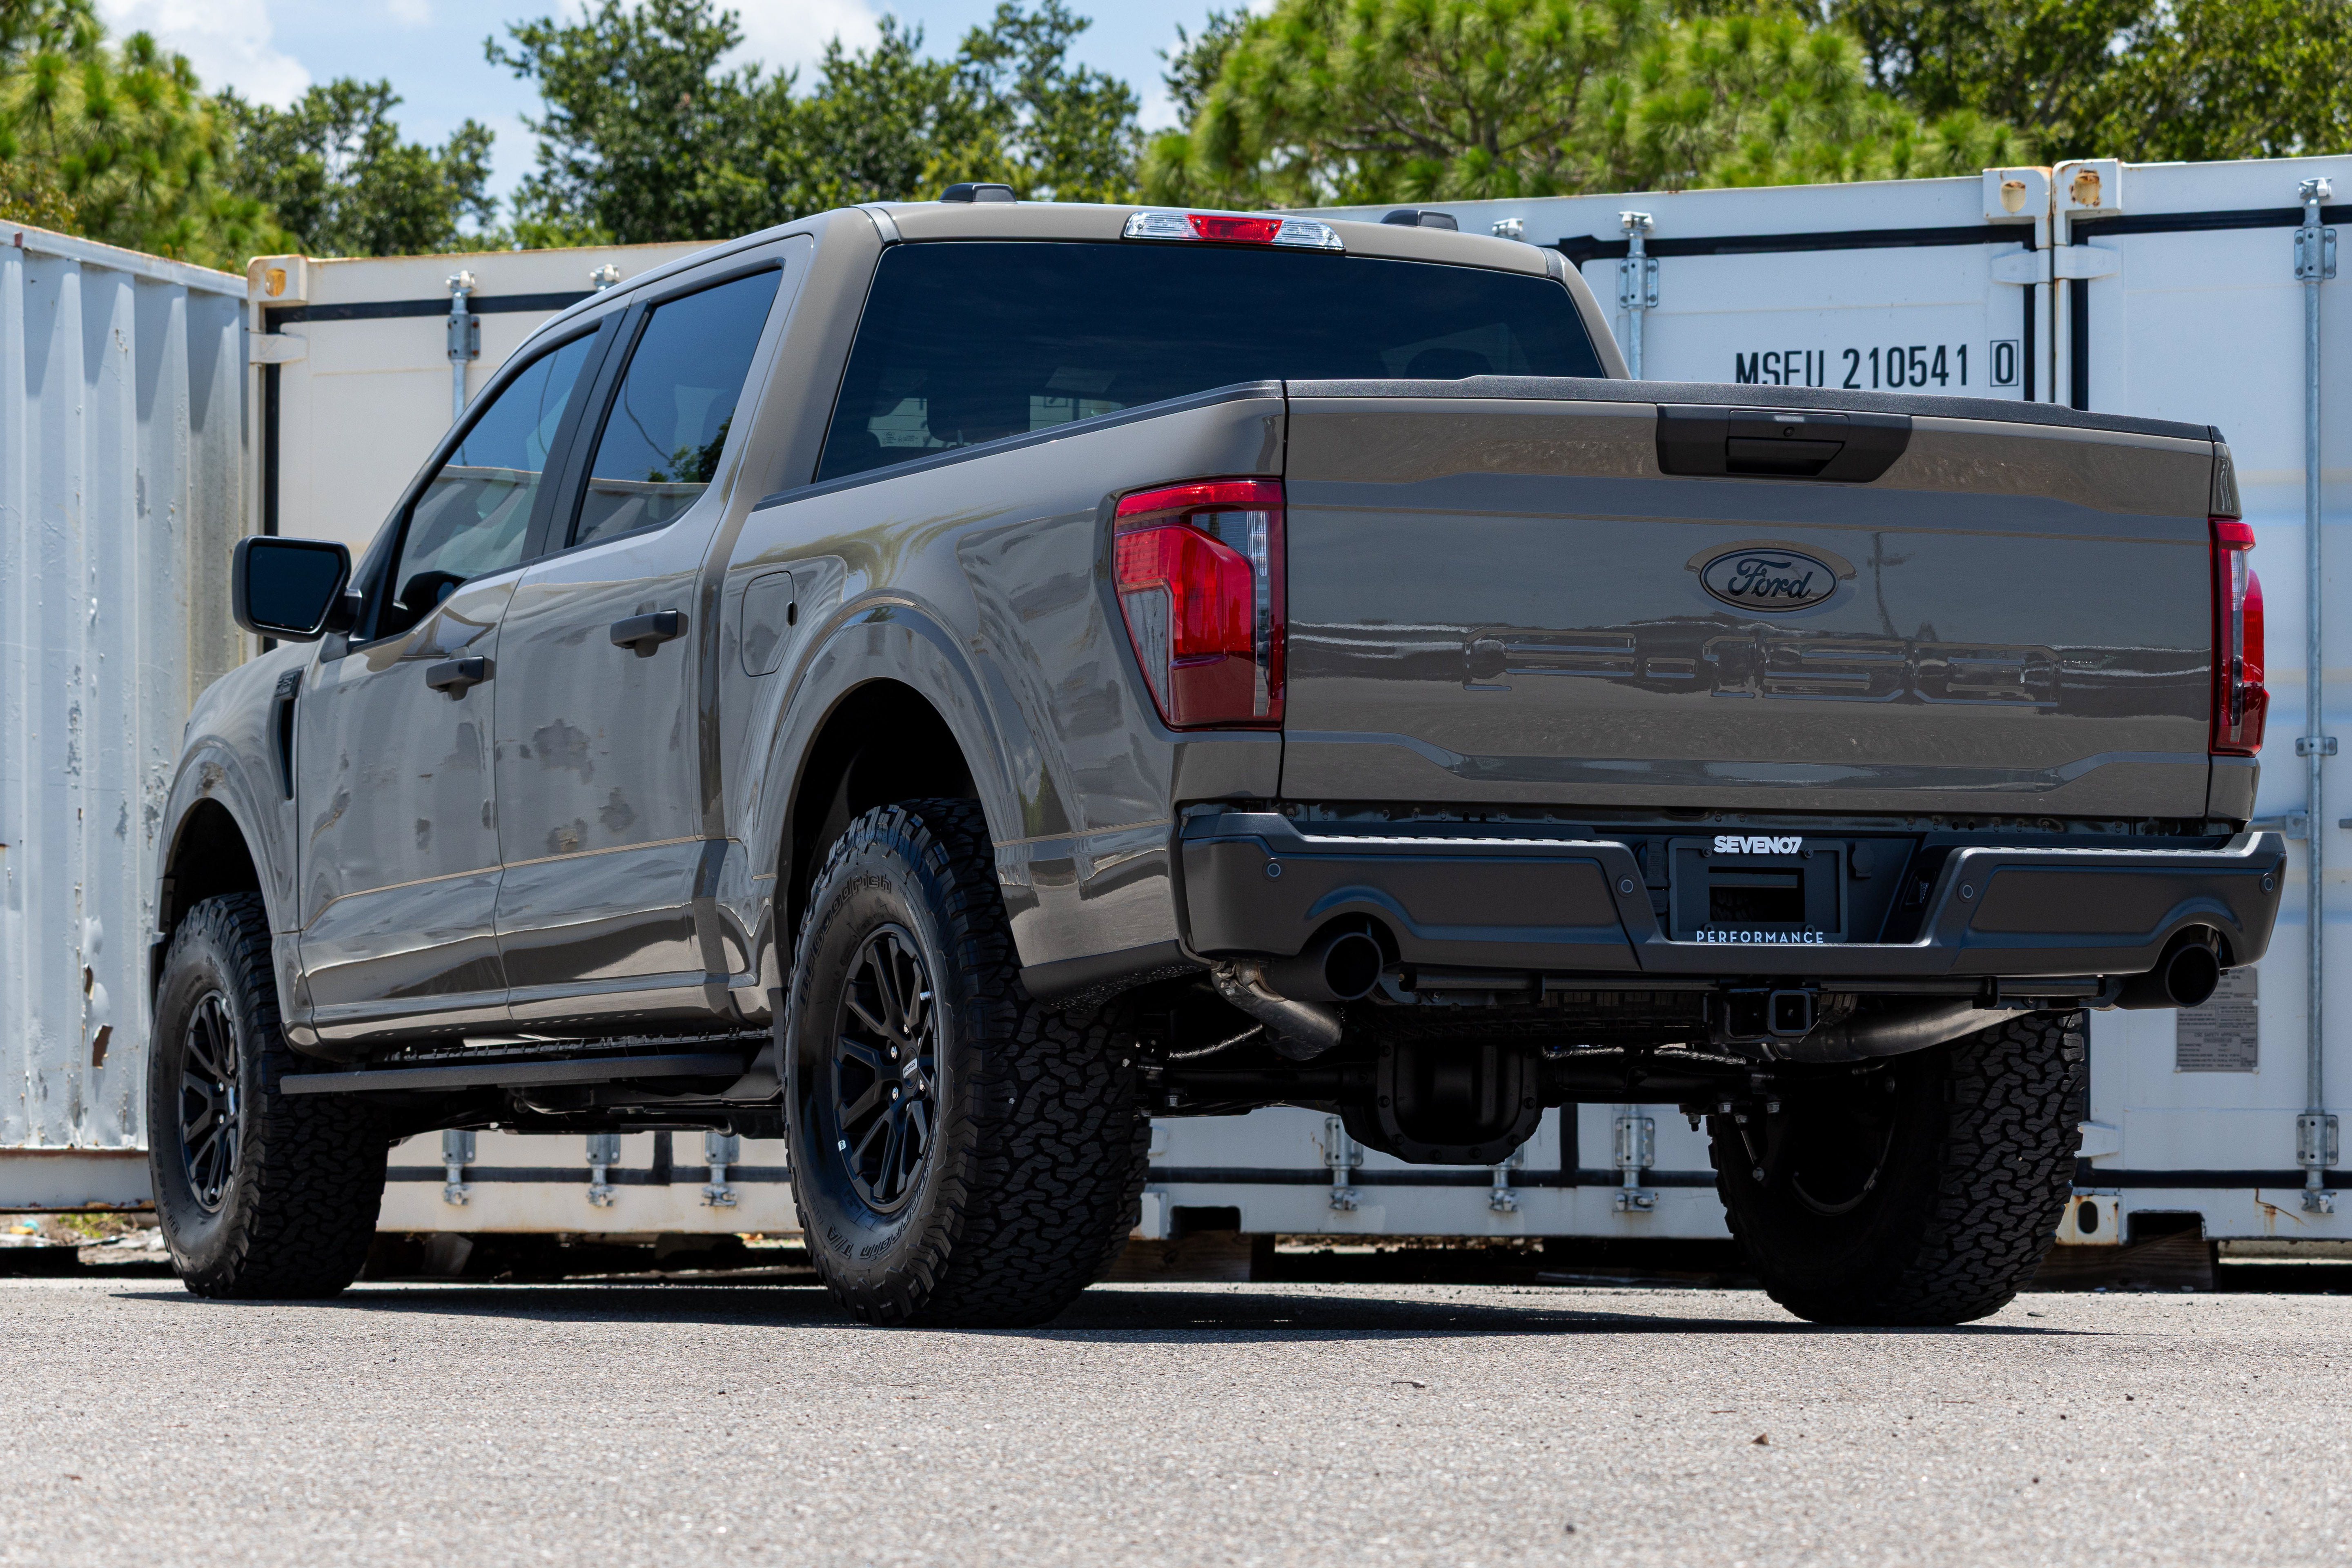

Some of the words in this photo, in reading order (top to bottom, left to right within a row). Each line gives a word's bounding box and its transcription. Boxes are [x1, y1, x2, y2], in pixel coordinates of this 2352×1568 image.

[1842, 344, 1967, 389] 210541
[1995, 343, 2013, 384] 0
[1728, 558, 1813, 599] Ford
[800, 870, 892, 1010] BFGoodrich
[1697, 931, 1824, 944] PERFORMANCE
[904, 1062, 915, 1074] FORD
[825, 1223, 854, 1259] T/A
